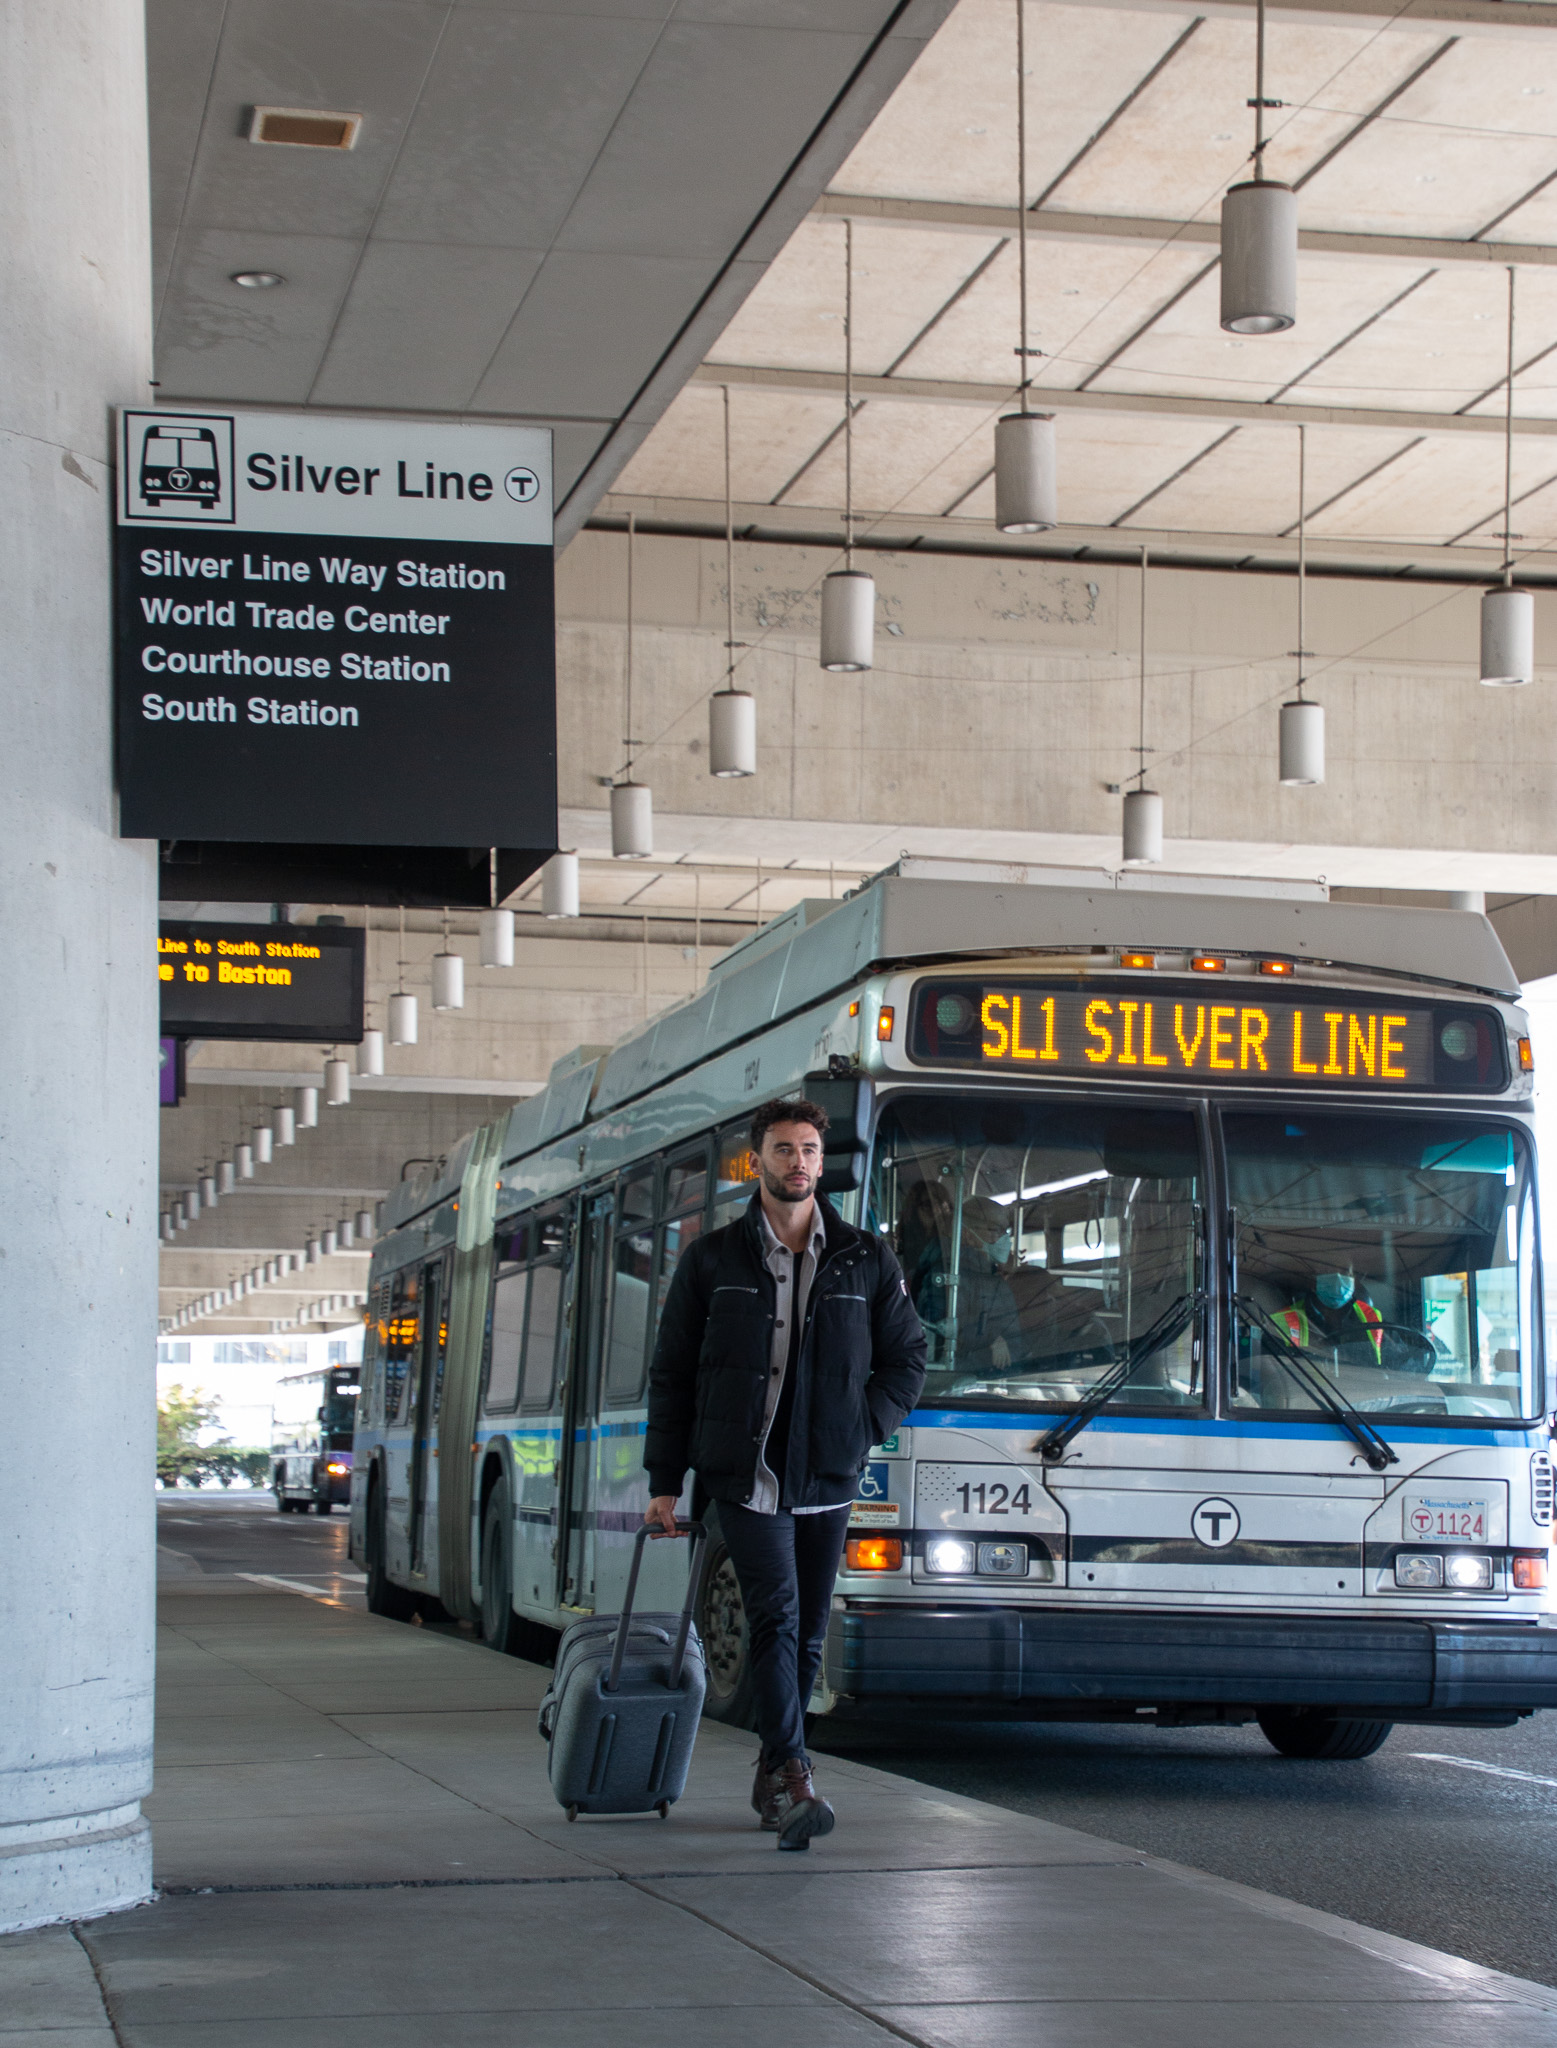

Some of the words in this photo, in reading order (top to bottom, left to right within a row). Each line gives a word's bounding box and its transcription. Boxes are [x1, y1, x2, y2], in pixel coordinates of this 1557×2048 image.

[247, 453, 379, 495] Silver
[398, 461, 493, 501] Line
[141, 549, 232, 578] Silver
[244, 554, 310, 582] Line
[320, 557, 387, 591] Way
[397, 561, 505, 590] Station
[140, 598, 234, 626] World
[245, 602, 334, 630] Trade
[345, 606, 450, 634] Center
[142, 646, 330, 678] Courthouse
[341, 653, 449, 681] Station
[143, 694, 236, 722] South
[248, 697, 358, 726] Station
[157, 938, 188, 953] Line
[194, 939, 212, 954] to
[217, 940, 260, 956] South
[266, 943, 320, 958] Station
[183, 962, 209, 982] to
[218, 961, 291, 985] Boston
[981, 994, 1059, 1060] SL1
[1085, 1000, 1269, 1070] SILVER
[1293, 1011, 1406, 1078] LINE
[858, 1504, 896, 1512] WARNING
[956, 1483, 1031, 1514] 1124
[1437, 1513, 1483, 1536] 1124
